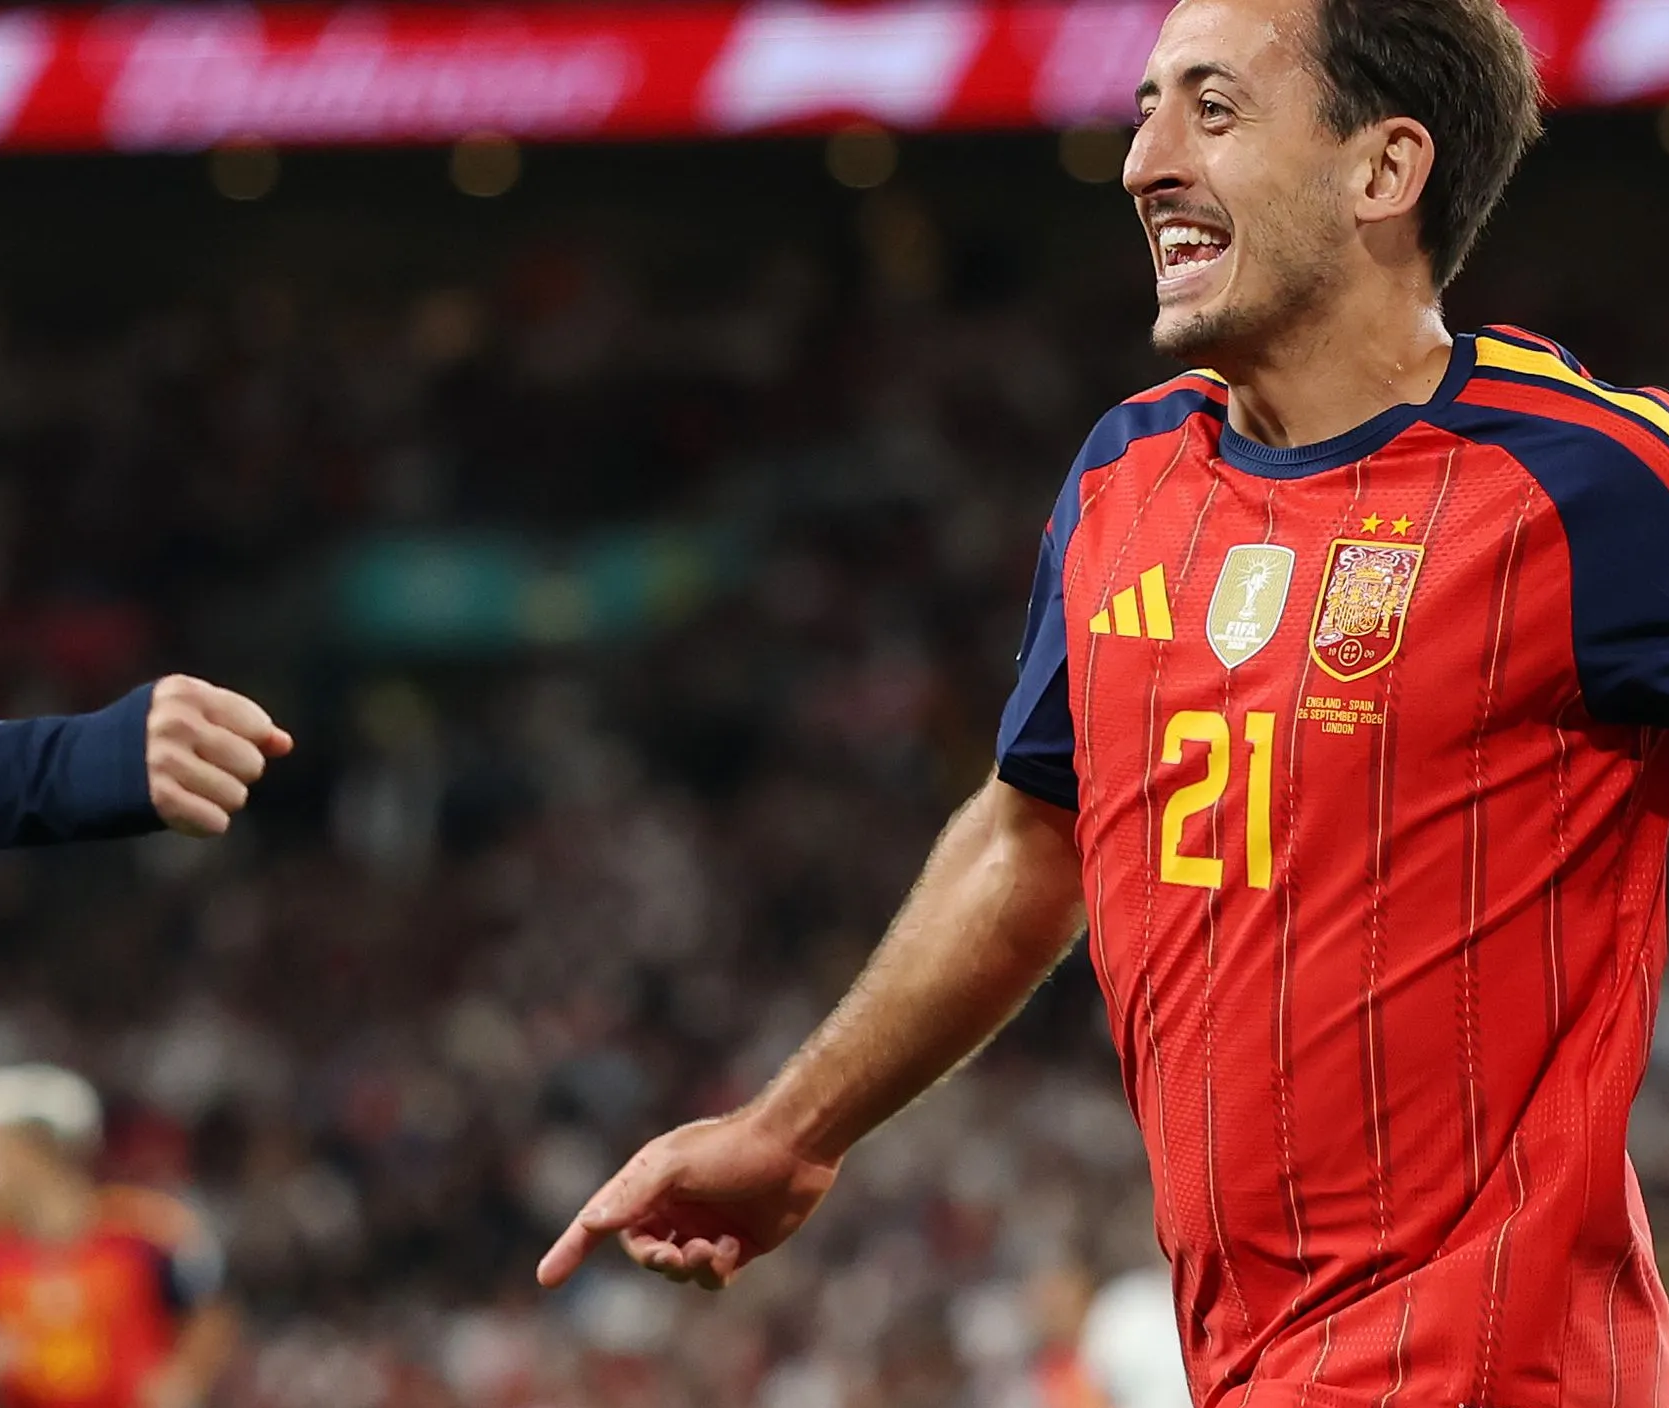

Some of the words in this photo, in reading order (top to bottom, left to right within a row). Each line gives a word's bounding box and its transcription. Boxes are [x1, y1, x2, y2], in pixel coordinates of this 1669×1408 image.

[1225, 620, 1256, 637] FIFA
[1305, 696, 1342, 710] ENGLAND
[1348, 699, 1375, 712] SPAIN
[1298, 708, 1309, 719] 26
[1309, 708, 1359, 723] SEPTEMBER
[1360, 712, 1384, 724] 2026
[1321, 721, 1355, 735] LONDON
[1160, 710, 1276, 890] 21
